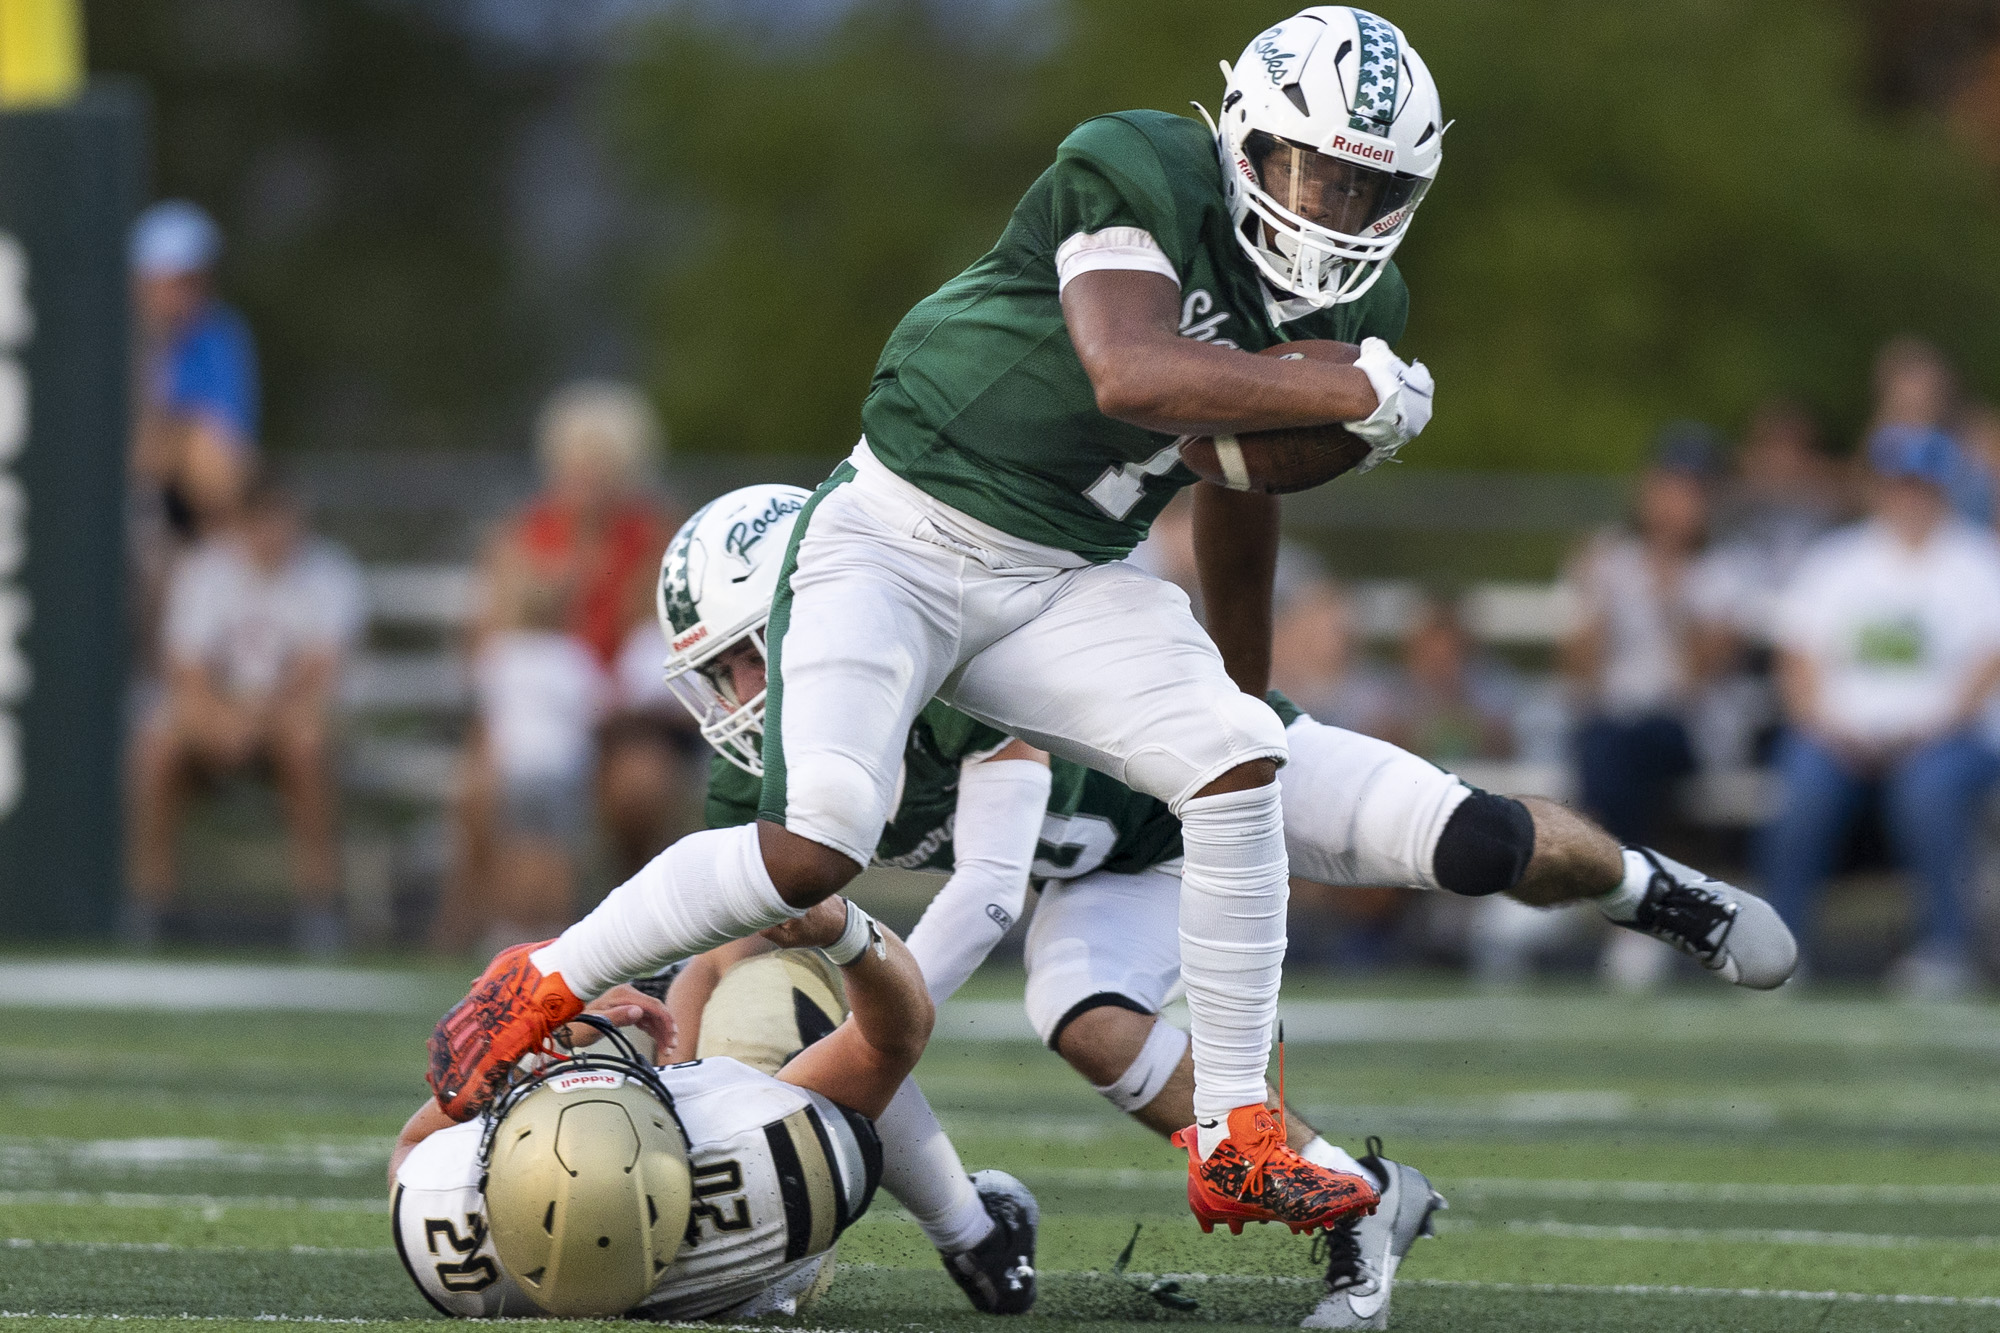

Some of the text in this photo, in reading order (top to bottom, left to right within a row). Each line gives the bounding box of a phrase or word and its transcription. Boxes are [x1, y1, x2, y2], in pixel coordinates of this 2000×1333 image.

[1253, 28, 1296, 86] Rocks
[1332, 135, 1395, 164] Riddell
[560, 1075, 616, 1089] Riddell
[686, 1158, 753, 1240] 20
[424, 1212, 500, 1294] 20
